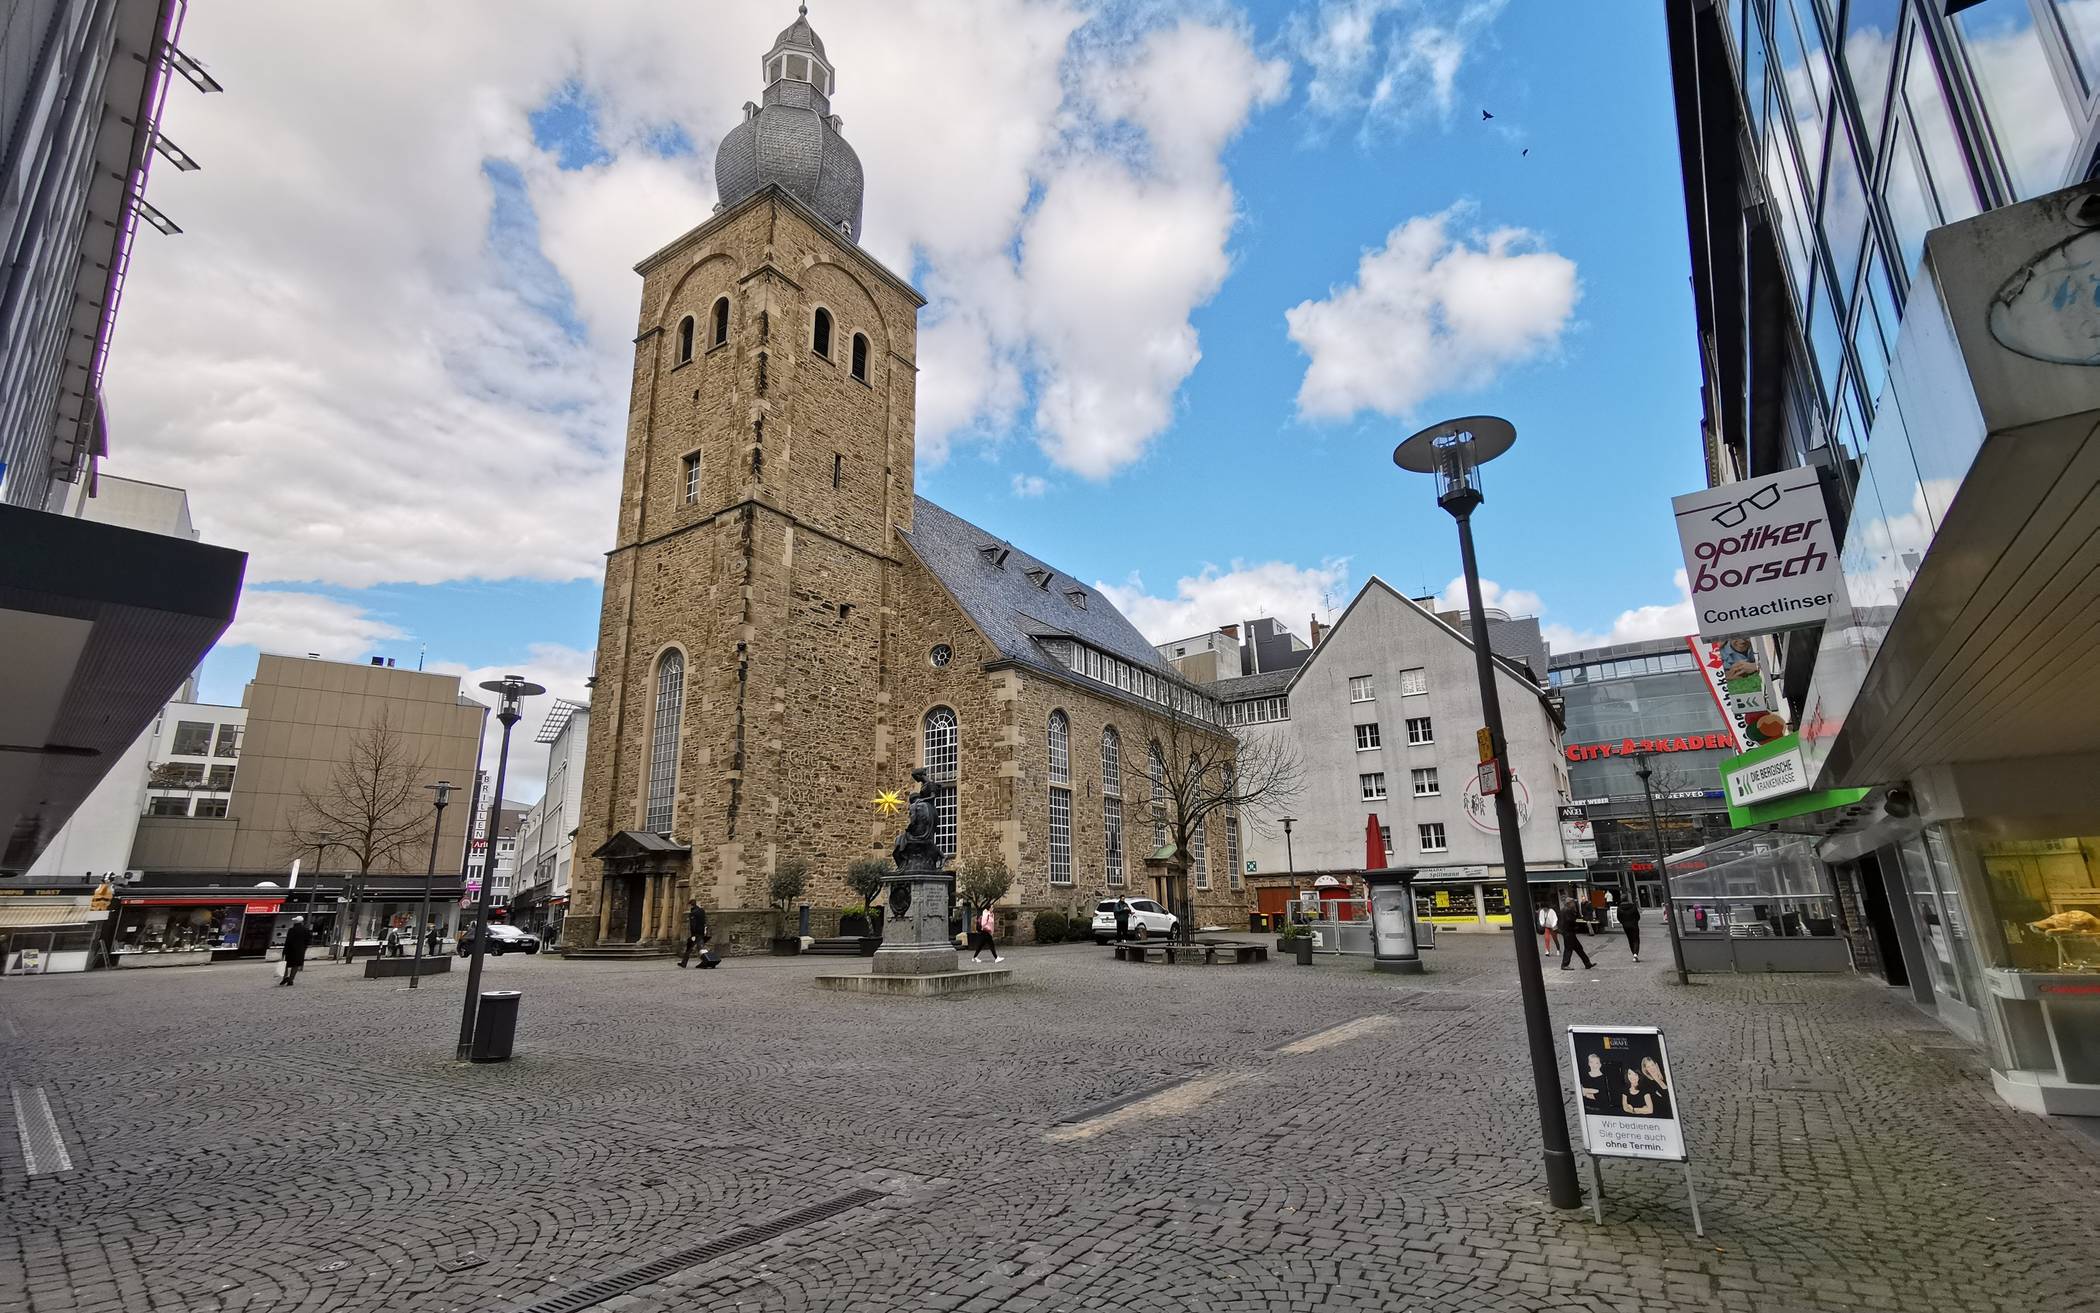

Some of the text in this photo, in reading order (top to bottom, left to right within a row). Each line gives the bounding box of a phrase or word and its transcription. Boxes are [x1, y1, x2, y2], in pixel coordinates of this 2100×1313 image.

[1694, 518, 1823, 568] optiker
[1693, 542, 1829, 594] borsch
[1566, 734, 1733, 762] CITY-ARKADEN
[1750, 759, 1793, 784] DIE BERGISCHE
[1756, 772, 1796, 791] KRANKENKASSE
[1599, 1129, 1667, 1142] Sie gerne auch
[1619, 1121, 1661, 1131] bedienen
[1605, 1140, 1664, 1152] ohne Termin.
